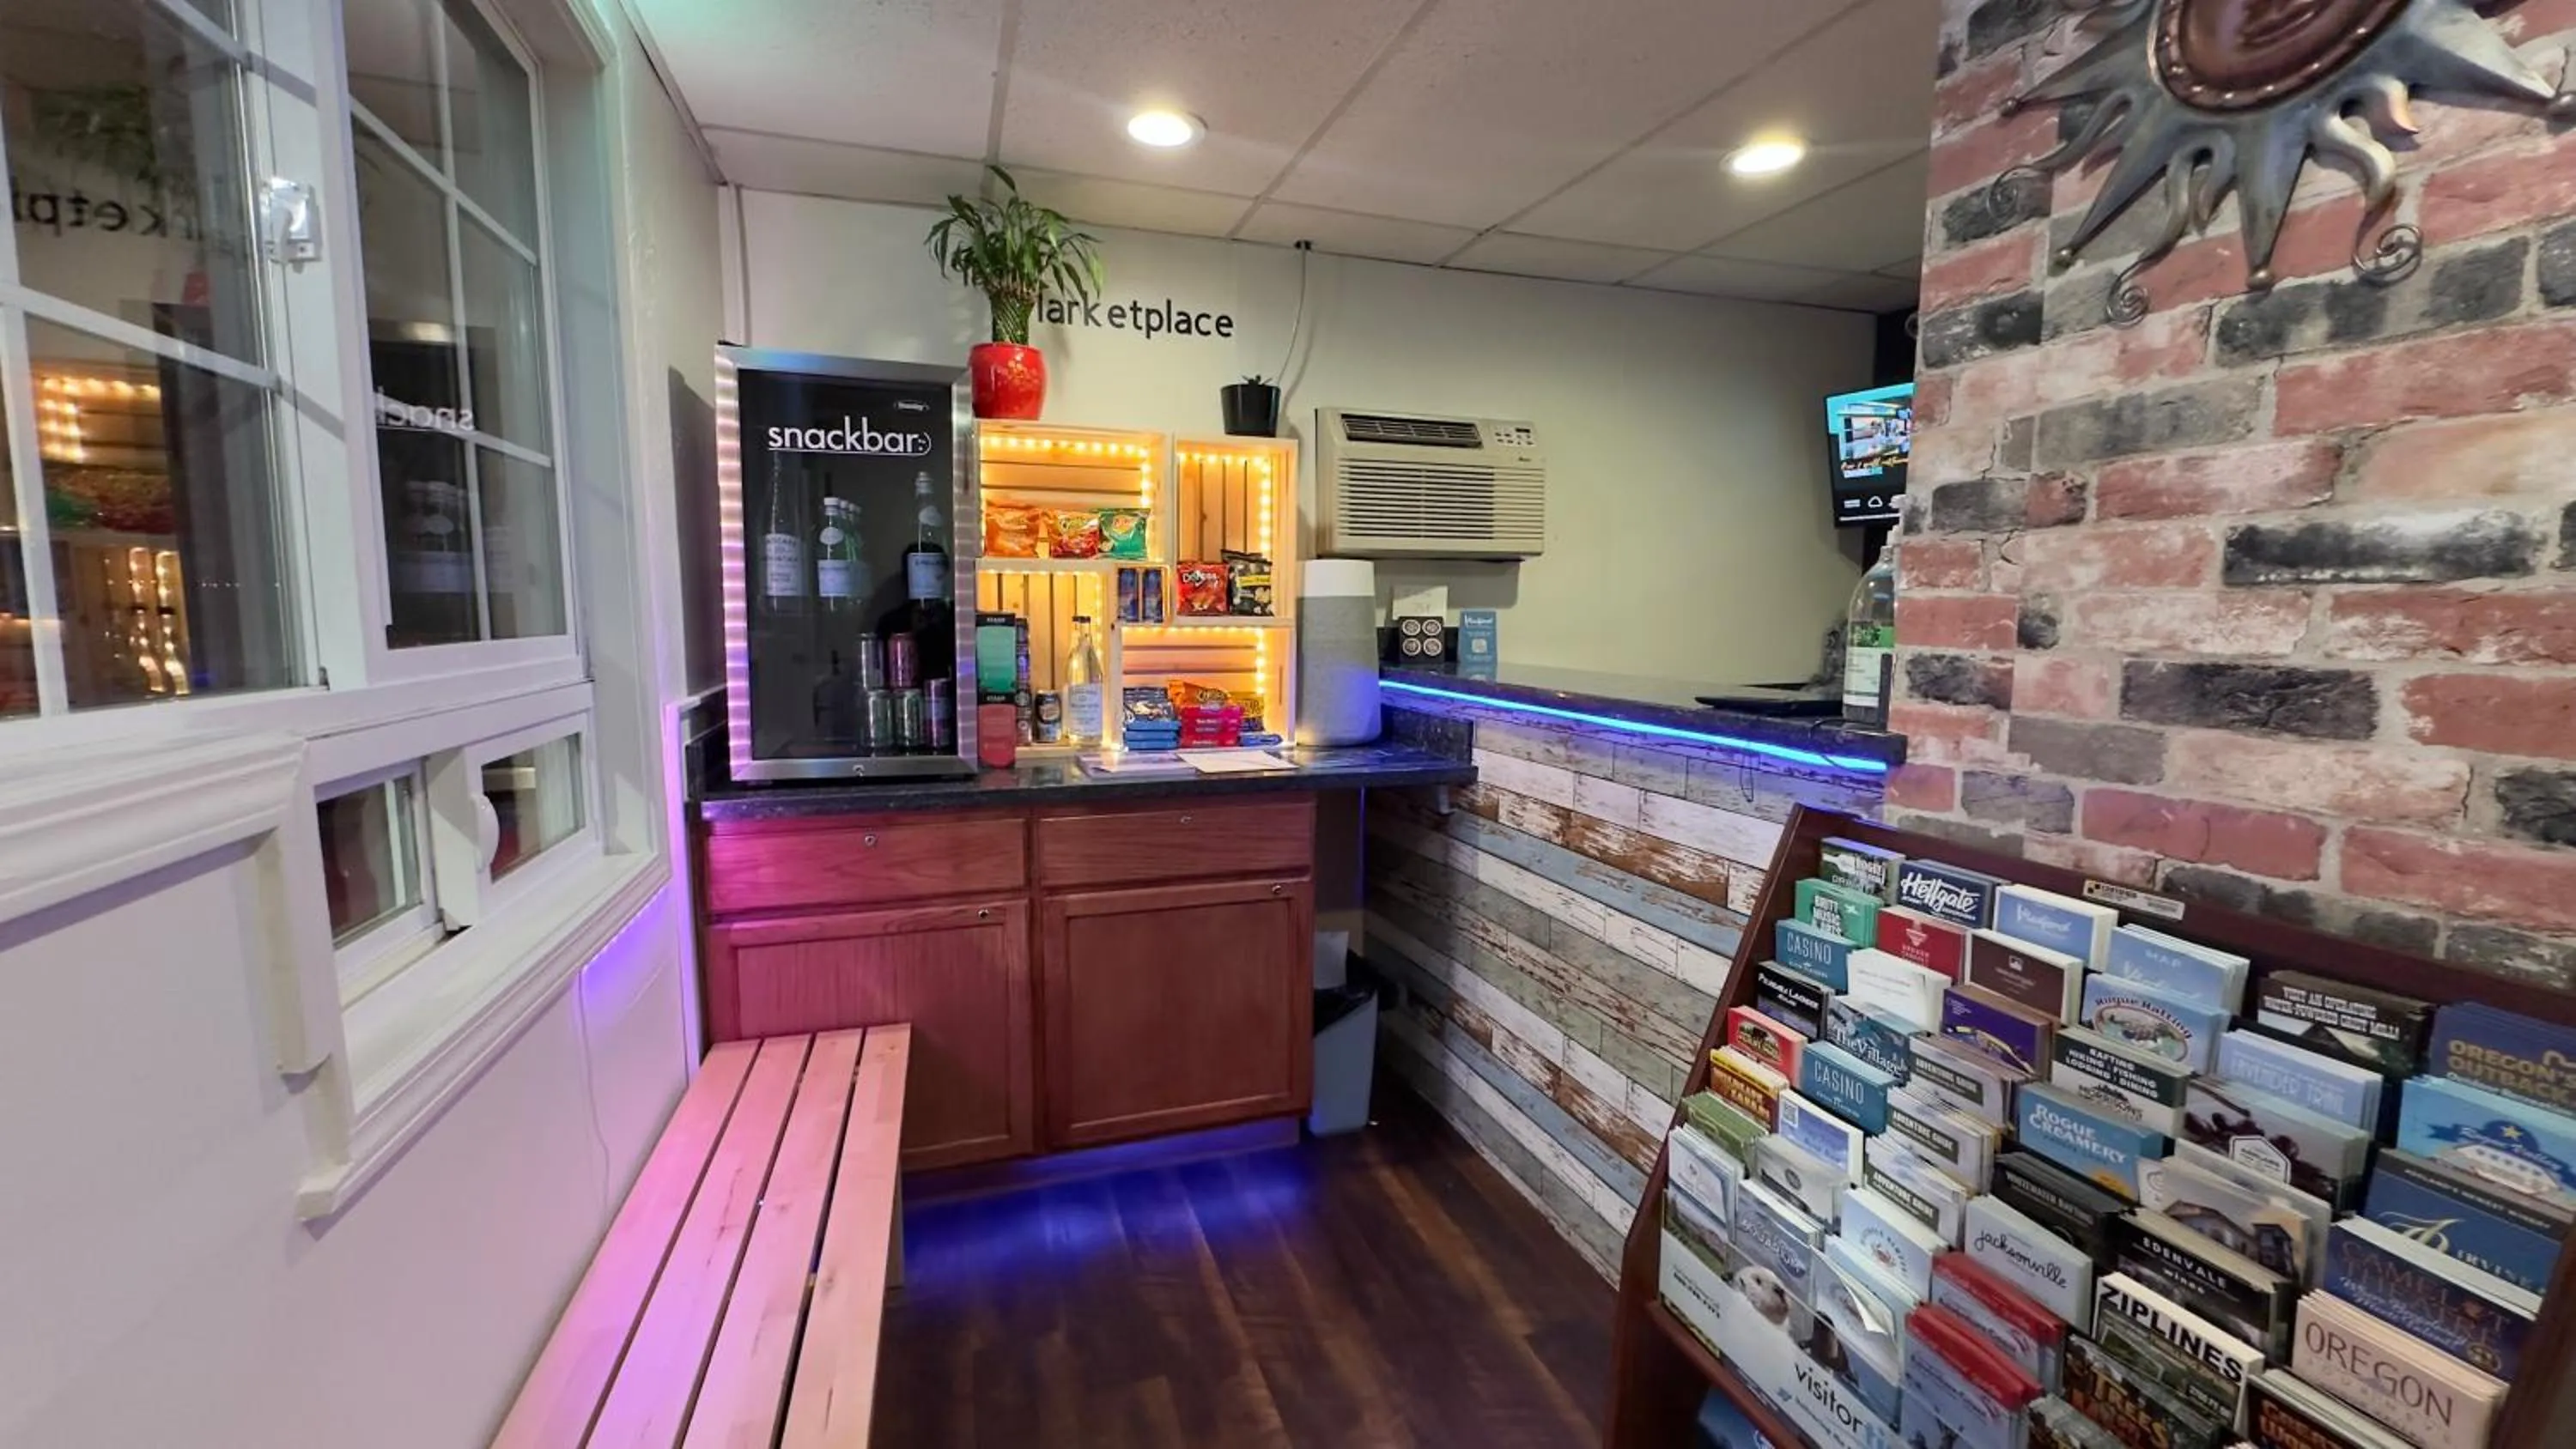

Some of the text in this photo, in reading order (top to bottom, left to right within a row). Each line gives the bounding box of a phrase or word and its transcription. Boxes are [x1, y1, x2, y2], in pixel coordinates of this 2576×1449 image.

[1900, 871, 1981, 912] Hellgate
[1786, 931, 1832, 966] CASINO
[1814, 1059, 1865, 1105] CASINO
[2088, 1047, 2136, 1071] RAFTING
[2028, 1112, 2127, 1165] CREAMERY
[2034, 1102, 2097, 1139] ROGUE
[1974, 1228, 2069, 1288] jacksonville
[2142, 1236, 2228, 1288] EDENVALE
[2100, 1286, 2244, 1385] ZIPLINES
[1795, 1362, 1865, 1434] visitor
[2305, 1321, 2454, 1428] OREGON
